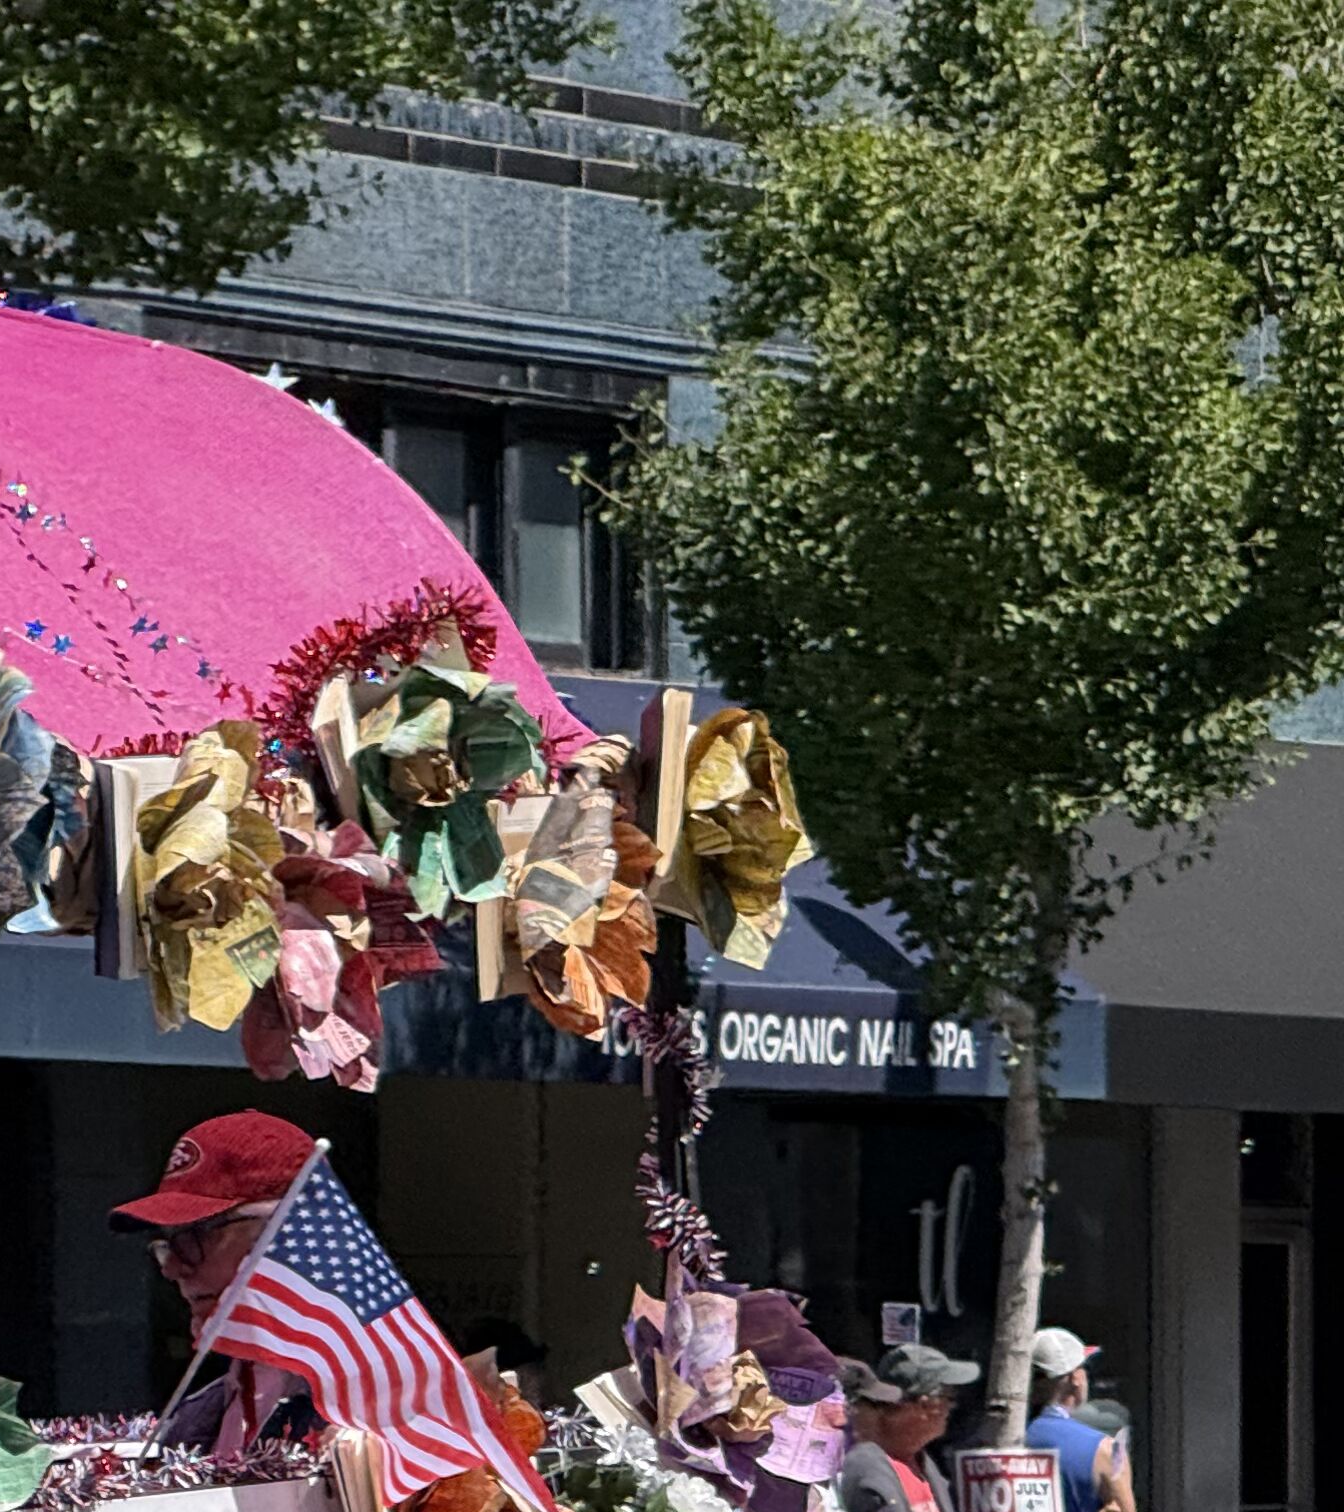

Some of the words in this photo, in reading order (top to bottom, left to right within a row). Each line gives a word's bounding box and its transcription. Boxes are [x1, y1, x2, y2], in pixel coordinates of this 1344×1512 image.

[719, 1011, 848, 1066] ORGANIC
[859, 1020, 916, 1067] NAIL
[929, 1021, 976, 1069] SPA
[1016, 1482, 1049, 1495] JULY
